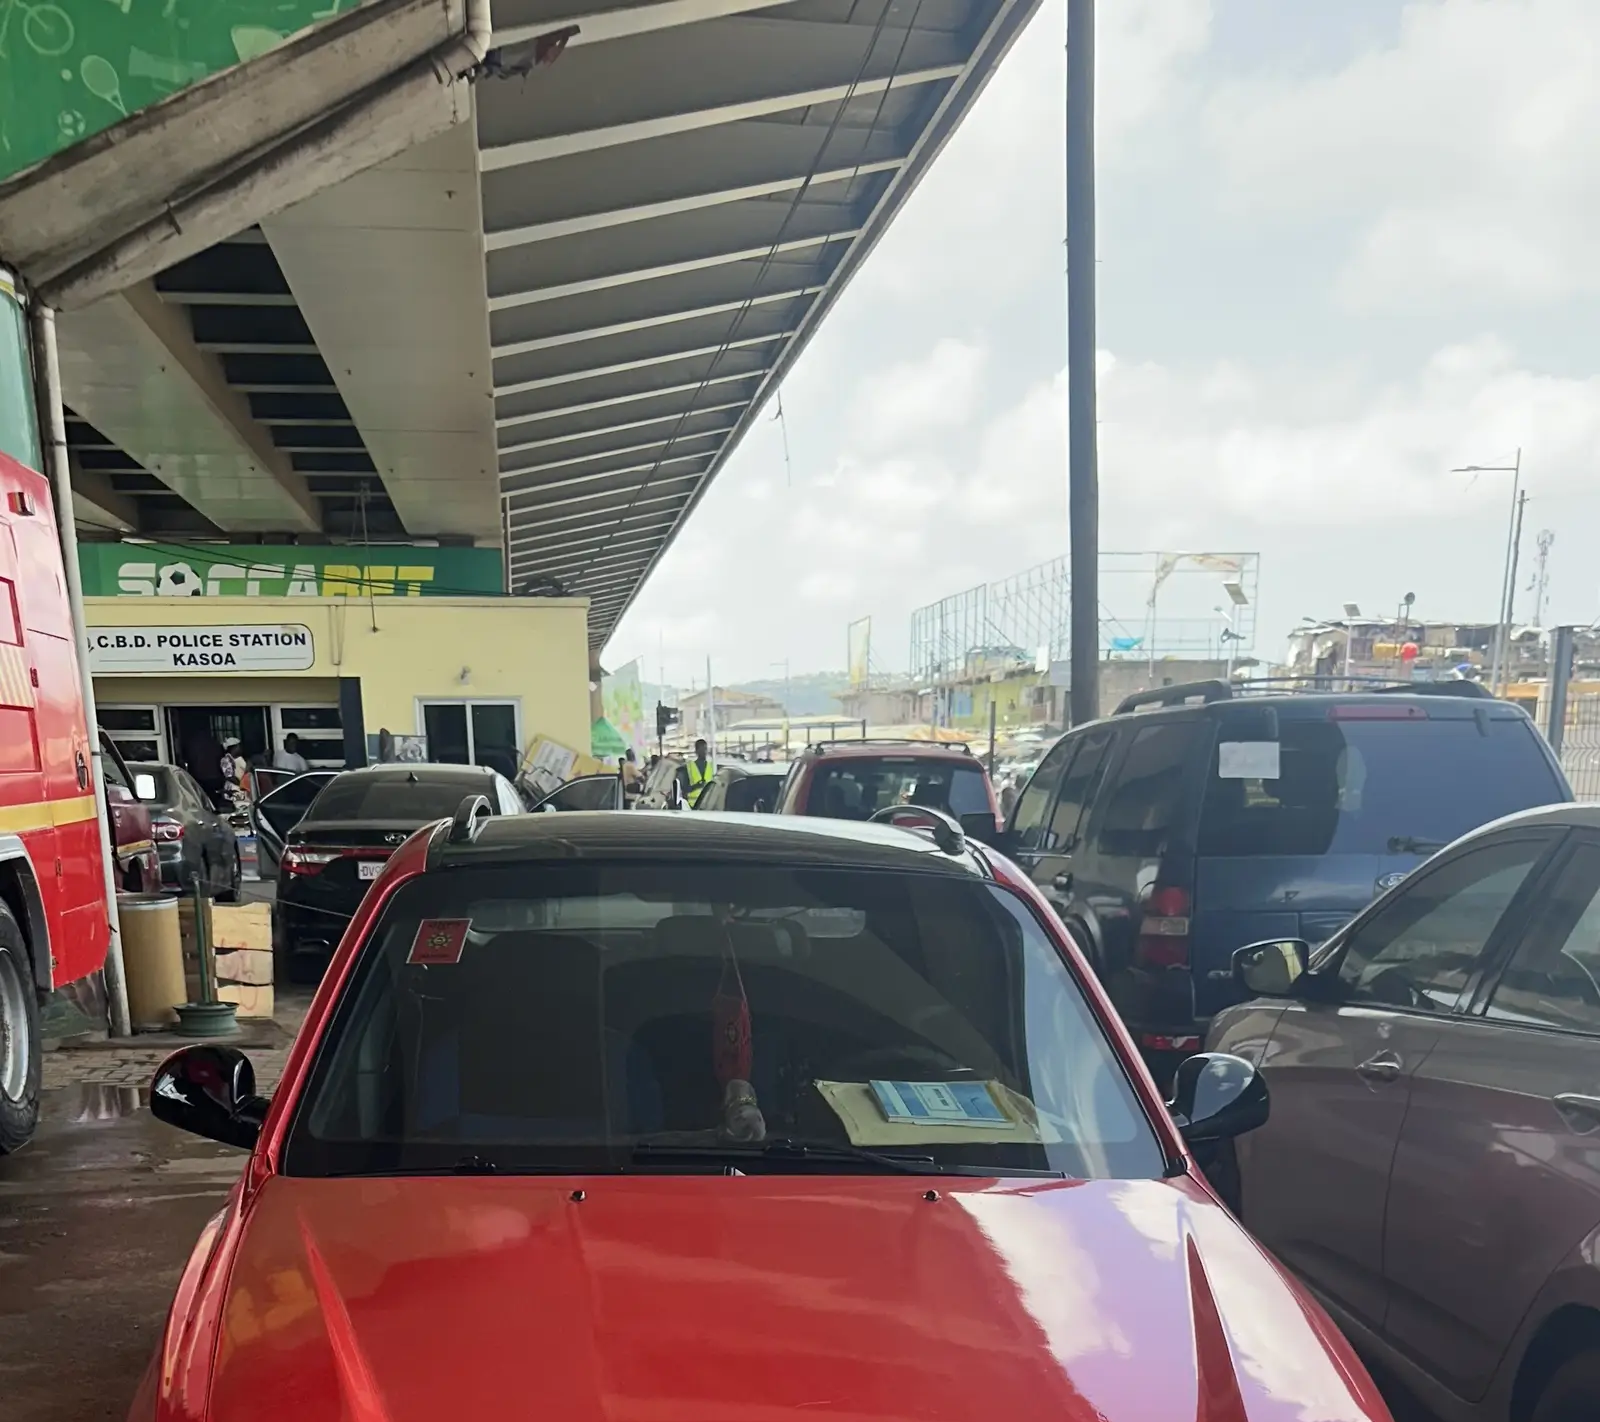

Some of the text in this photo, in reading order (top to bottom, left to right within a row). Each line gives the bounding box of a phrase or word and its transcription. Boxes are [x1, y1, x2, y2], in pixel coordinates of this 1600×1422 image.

[97, 633, 306, 648] C.B.D. POLICE STATION
[173, 653, 236, 666] KASOA
